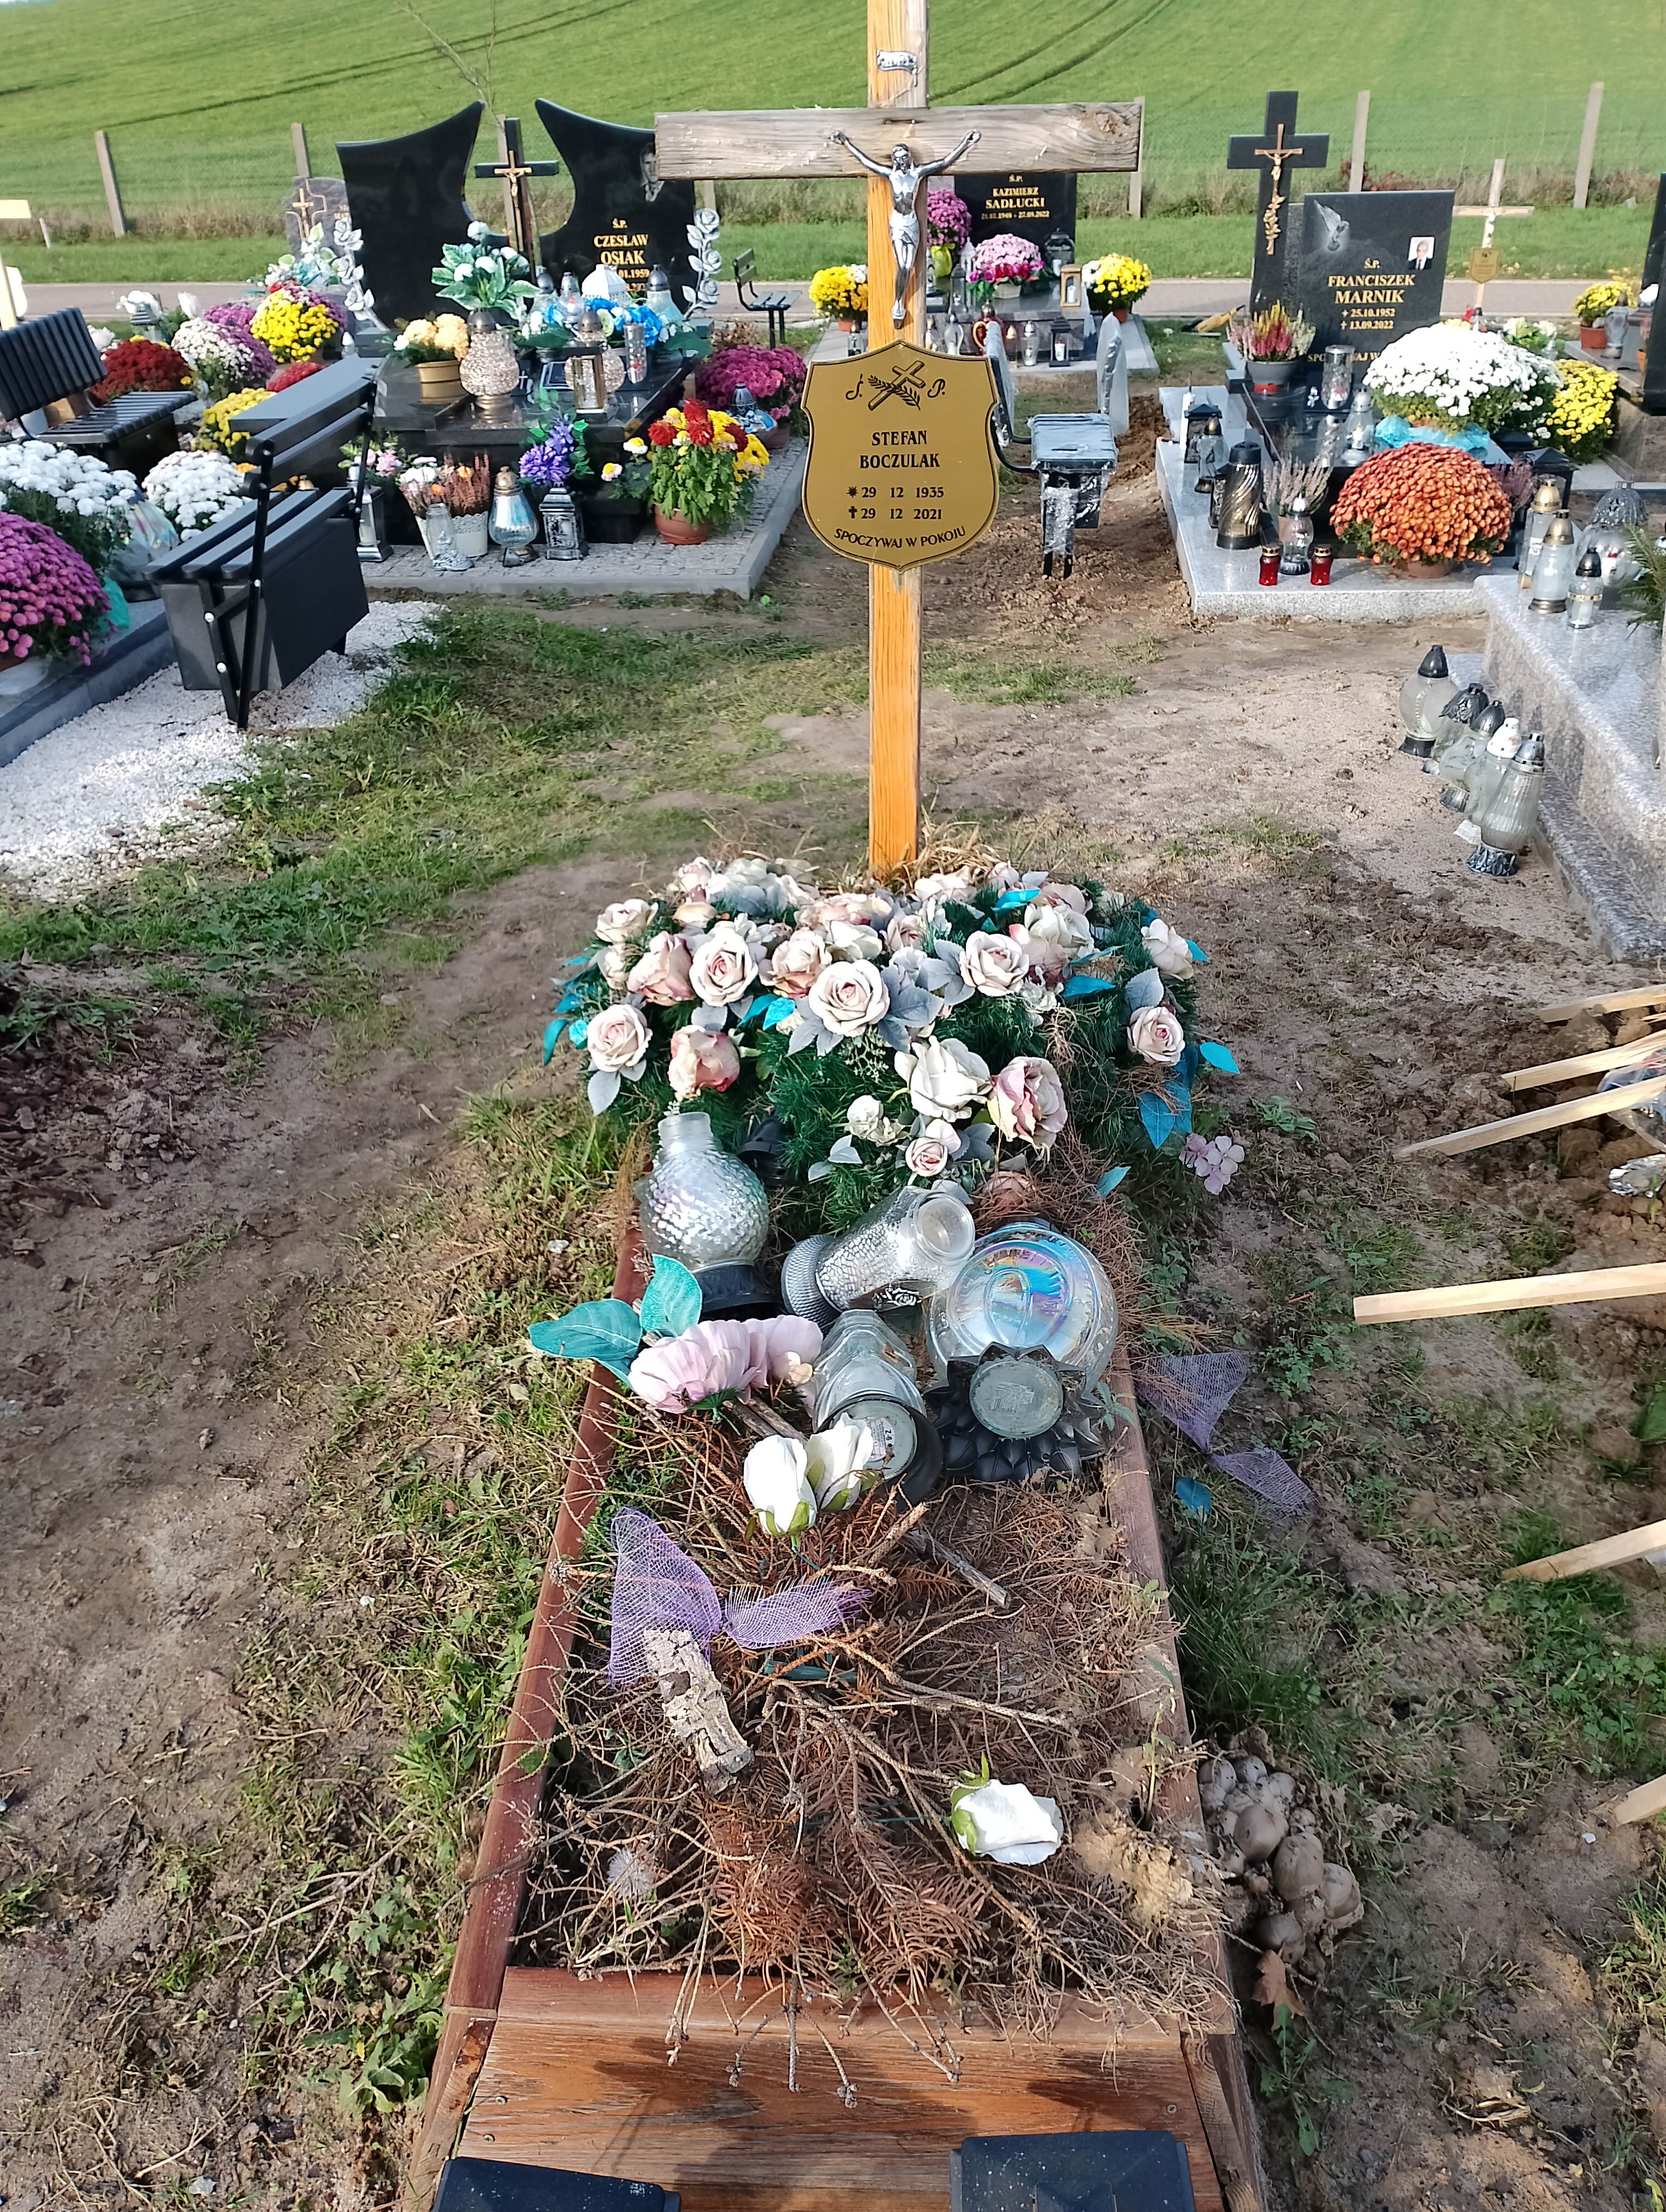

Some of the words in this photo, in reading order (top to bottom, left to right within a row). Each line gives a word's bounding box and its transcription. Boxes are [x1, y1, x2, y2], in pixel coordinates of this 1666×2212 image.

[992, 187, 1039, 197] KAZIMIERZ
[985, 197, 1045, 209] SADŁUCKI
[600, 250, 645, 265] OSIAK
[1327, 274, 1416, 287] FRANCISZEK
[1334, 290, 1405, 304] MARNIK
[871, 430, 928, 446] STEFAN
[859, 453, 941, 469] BOCZULAK
[861, 486, 877, 499] 29
[890, 487, 904, 498] 12
[915, 486, 945, 498] 1935
[860, 509, 876, 520] 29
[889, 509, 904, 520] 12
[913, 509, 943, 520] 2021
[834, 528, 902, 548] SPOCZYWAJ
[906, 537, 917, 548] W
[921, 525, 966, 547] POKOJU
